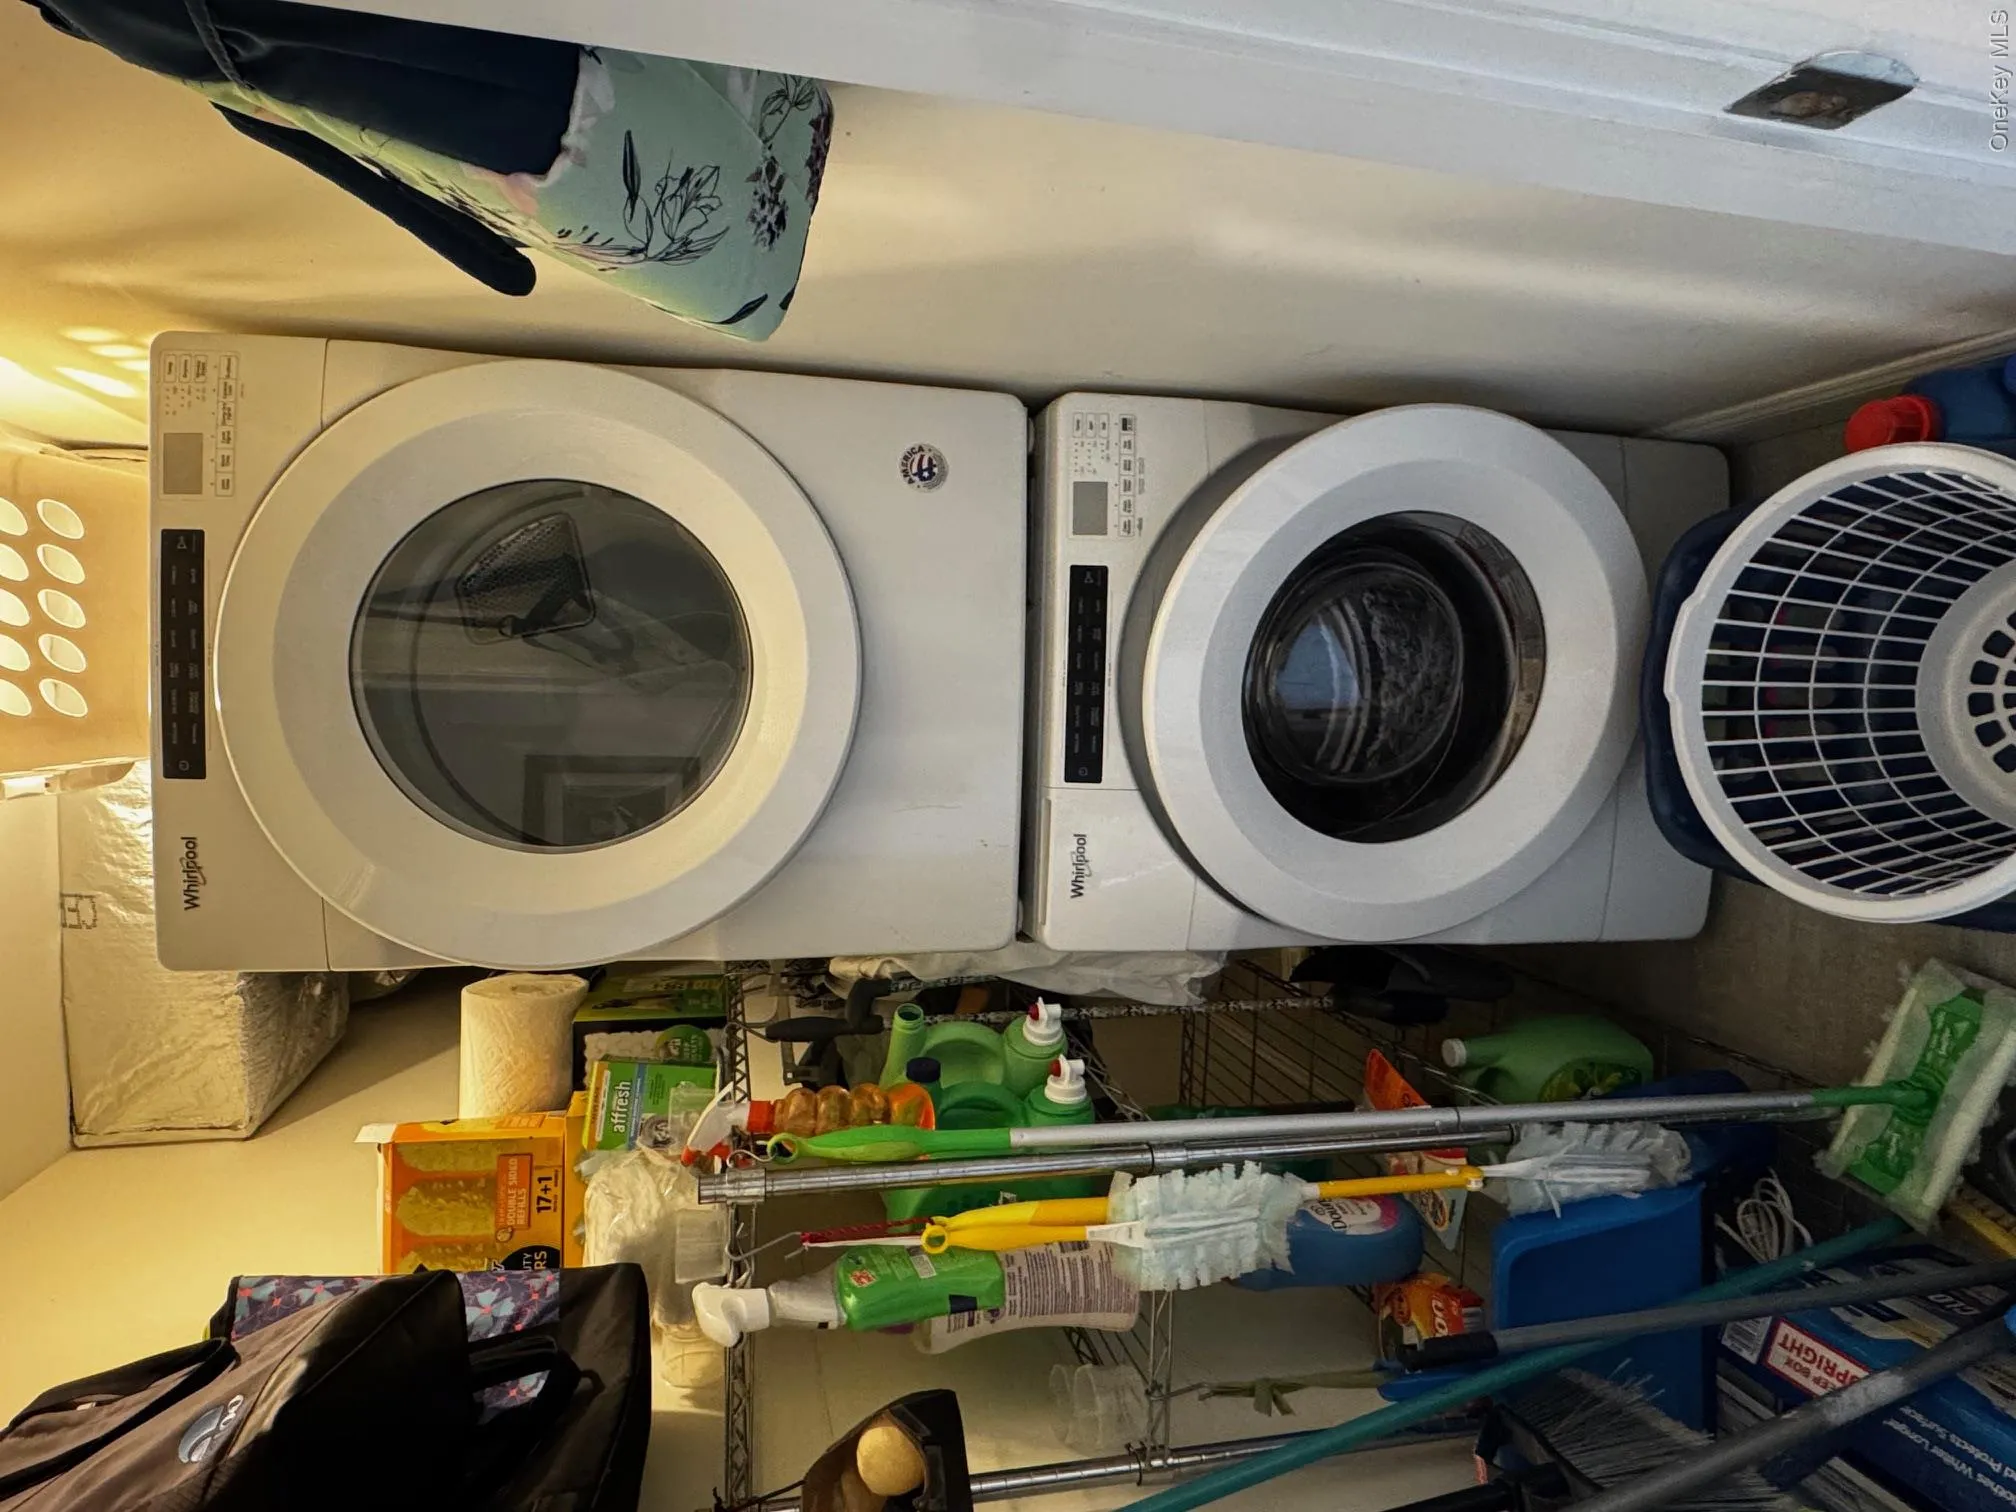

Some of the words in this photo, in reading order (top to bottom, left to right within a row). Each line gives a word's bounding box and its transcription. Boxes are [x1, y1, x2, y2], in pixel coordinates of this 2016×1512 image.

[901, 444, 925, 484] AMERICA
[180, 836, 206, 911] Whirlpool
[1070, 833, 1091, 899] Whirlpool
[610, 1081, 631, 1132] affresh
[507, 1188, 517, 1225] DOUBLE
[517, 1188, 527, 1225] REFILLS
[536, 1176, 552, 1214] 17+1
[1316, 1198, 1348, 1230] Down
[1784, 1355, 1811, 1378] BOX
[1882, 1418, 1930, 1452] Longer
[1949, 1433, 2002, 1473] Protects
